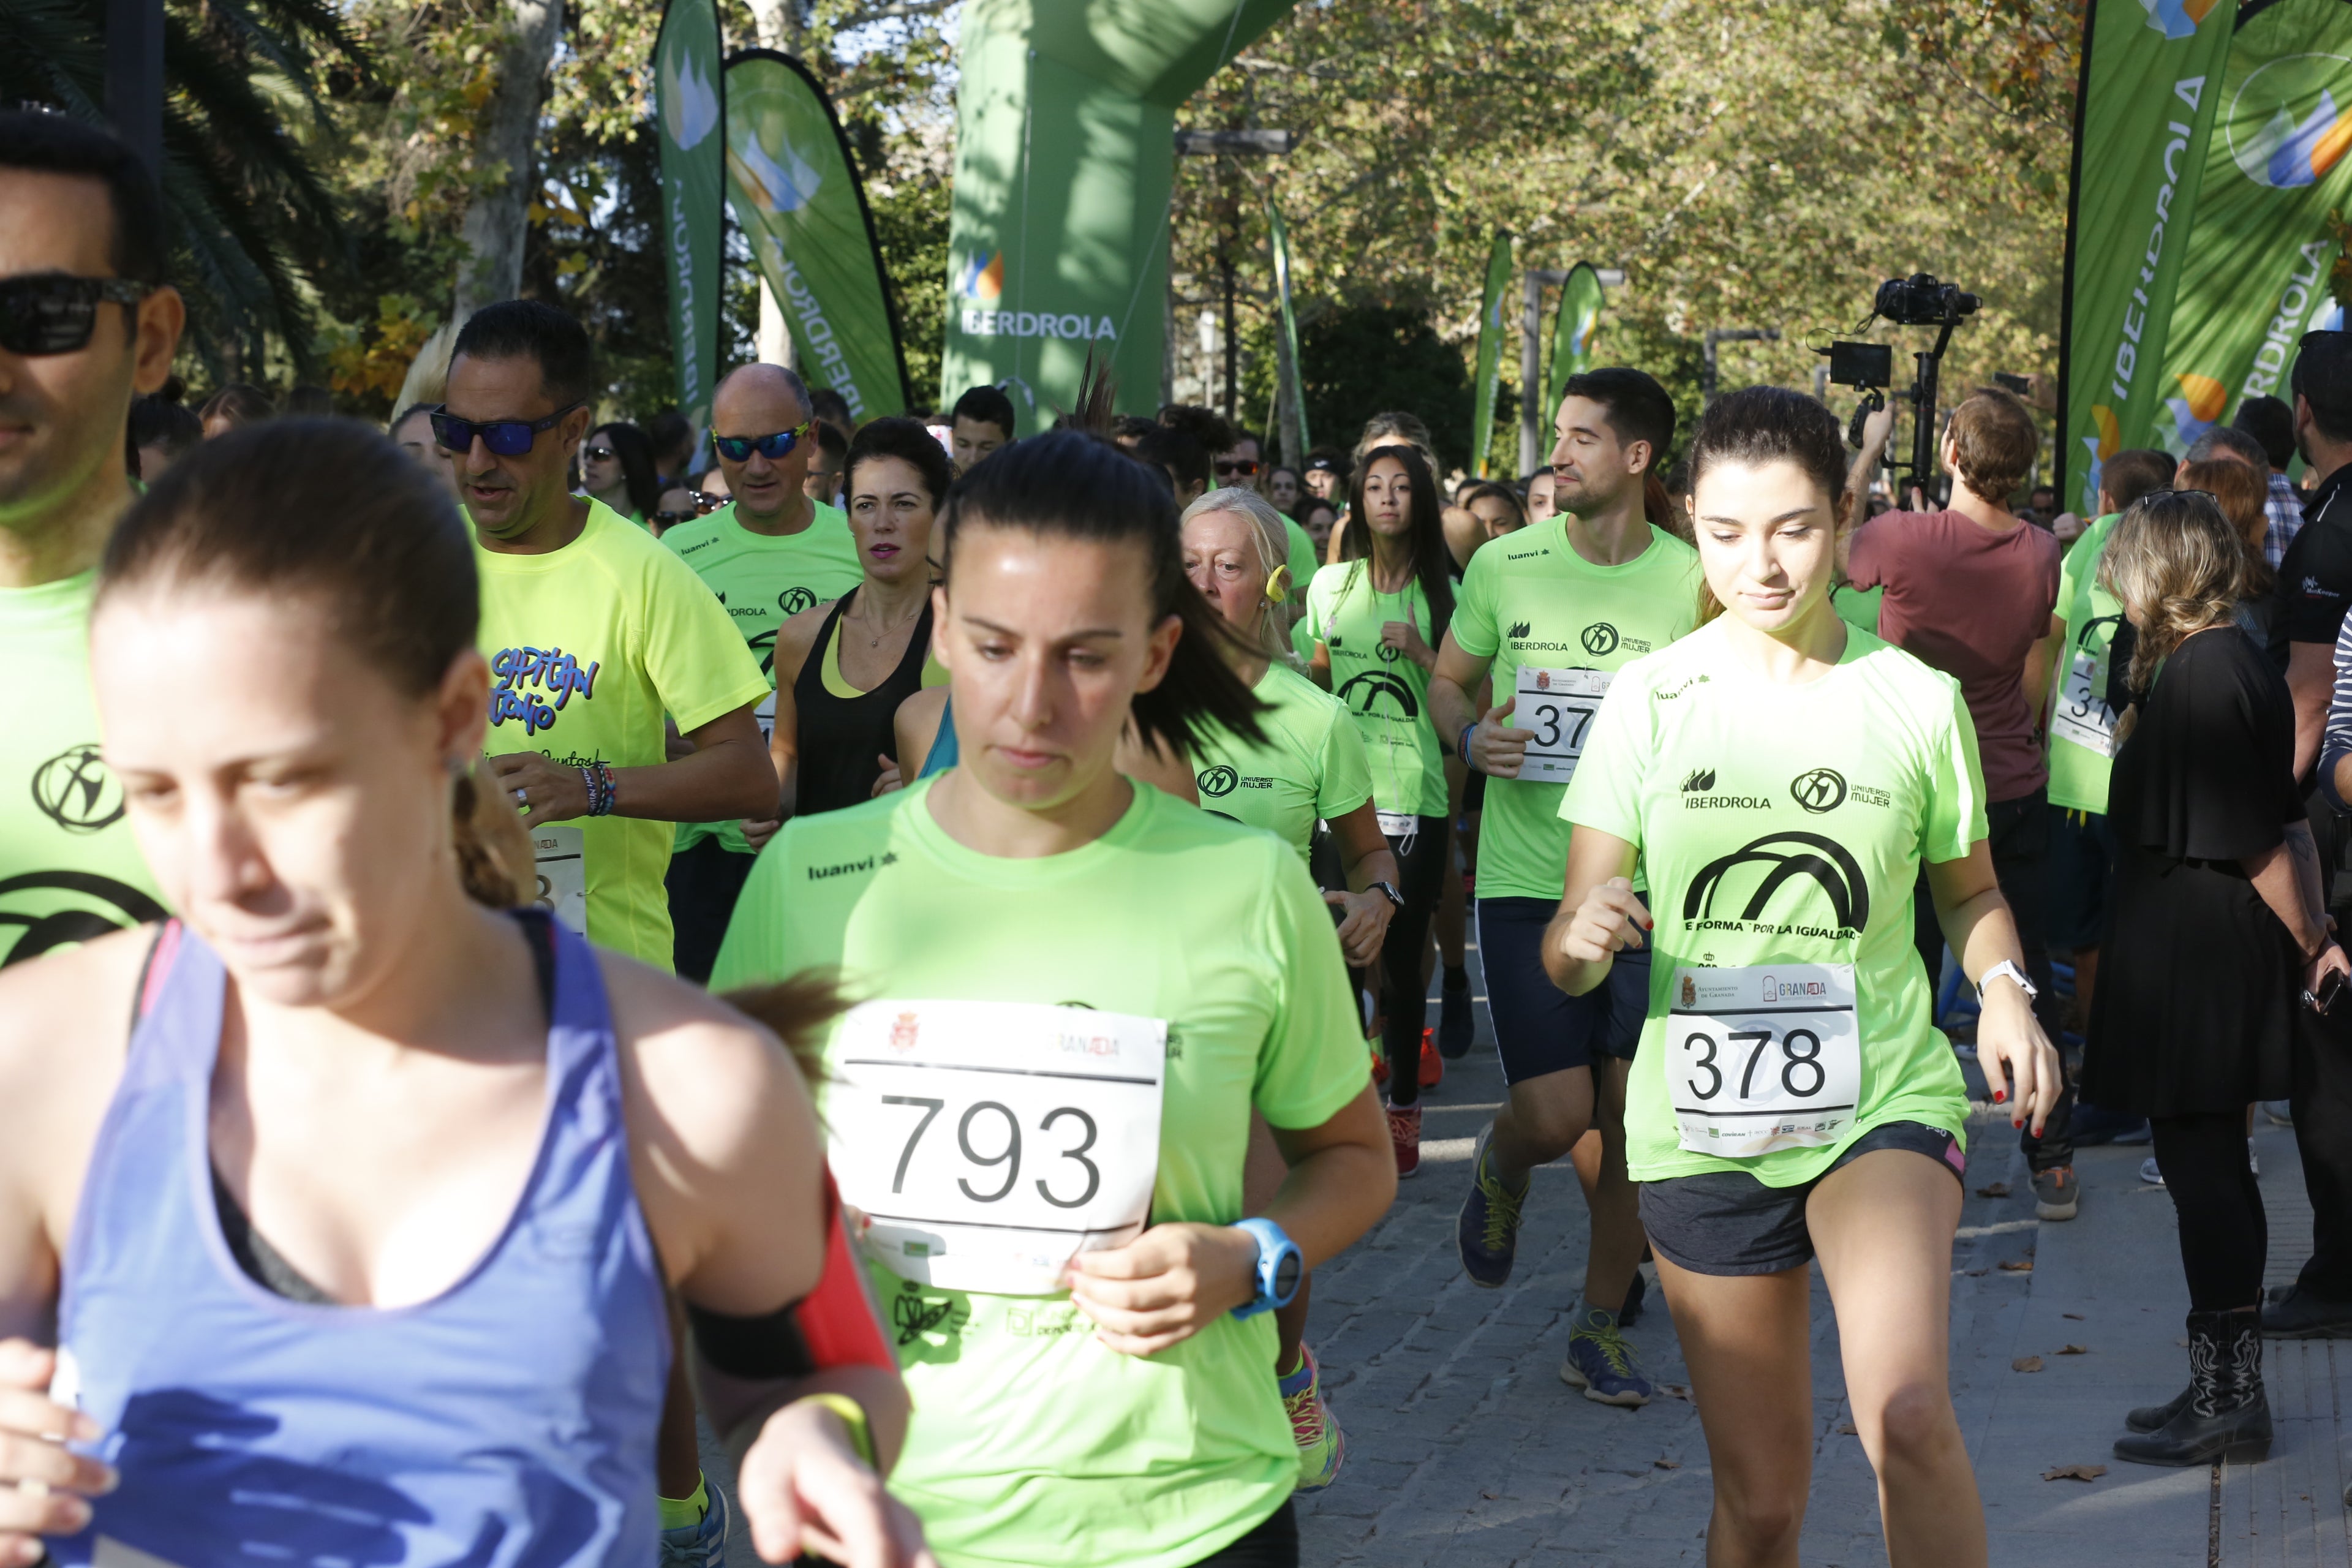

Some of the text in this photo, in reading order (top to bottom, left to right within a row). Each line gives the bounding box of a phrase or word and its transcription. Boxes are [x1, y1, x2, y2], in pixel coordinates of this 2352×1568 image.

[961, 309, 1117, 341] IBERDROLA
[2234, 238, 2328, 418] RDROLA
[680, 540, 710, 556] luanvi
[1507, 550, 1538, 560] luanvi
[1510, 641, 1568, 651] IBERDROLA
[1620, 643, 1650, 654] MUJER
[1656, 677, 1694, 701] luanvi
[1850, 784, 1891, 798] UNIVERSO
[1685, 797, 1771, 809] IBERDROLA
[1850, 793, 1890, 809] MUJER
[808, 856, 875, 881] luanvi
[1686, 921, 1856, 940] E FORMA POR LA IGUALDAD
[1779, 982, 1827, 996] GRANADA
[1684, 1028, 1826, 1101] 378
[881, 1095, 1101, 1209] 793
